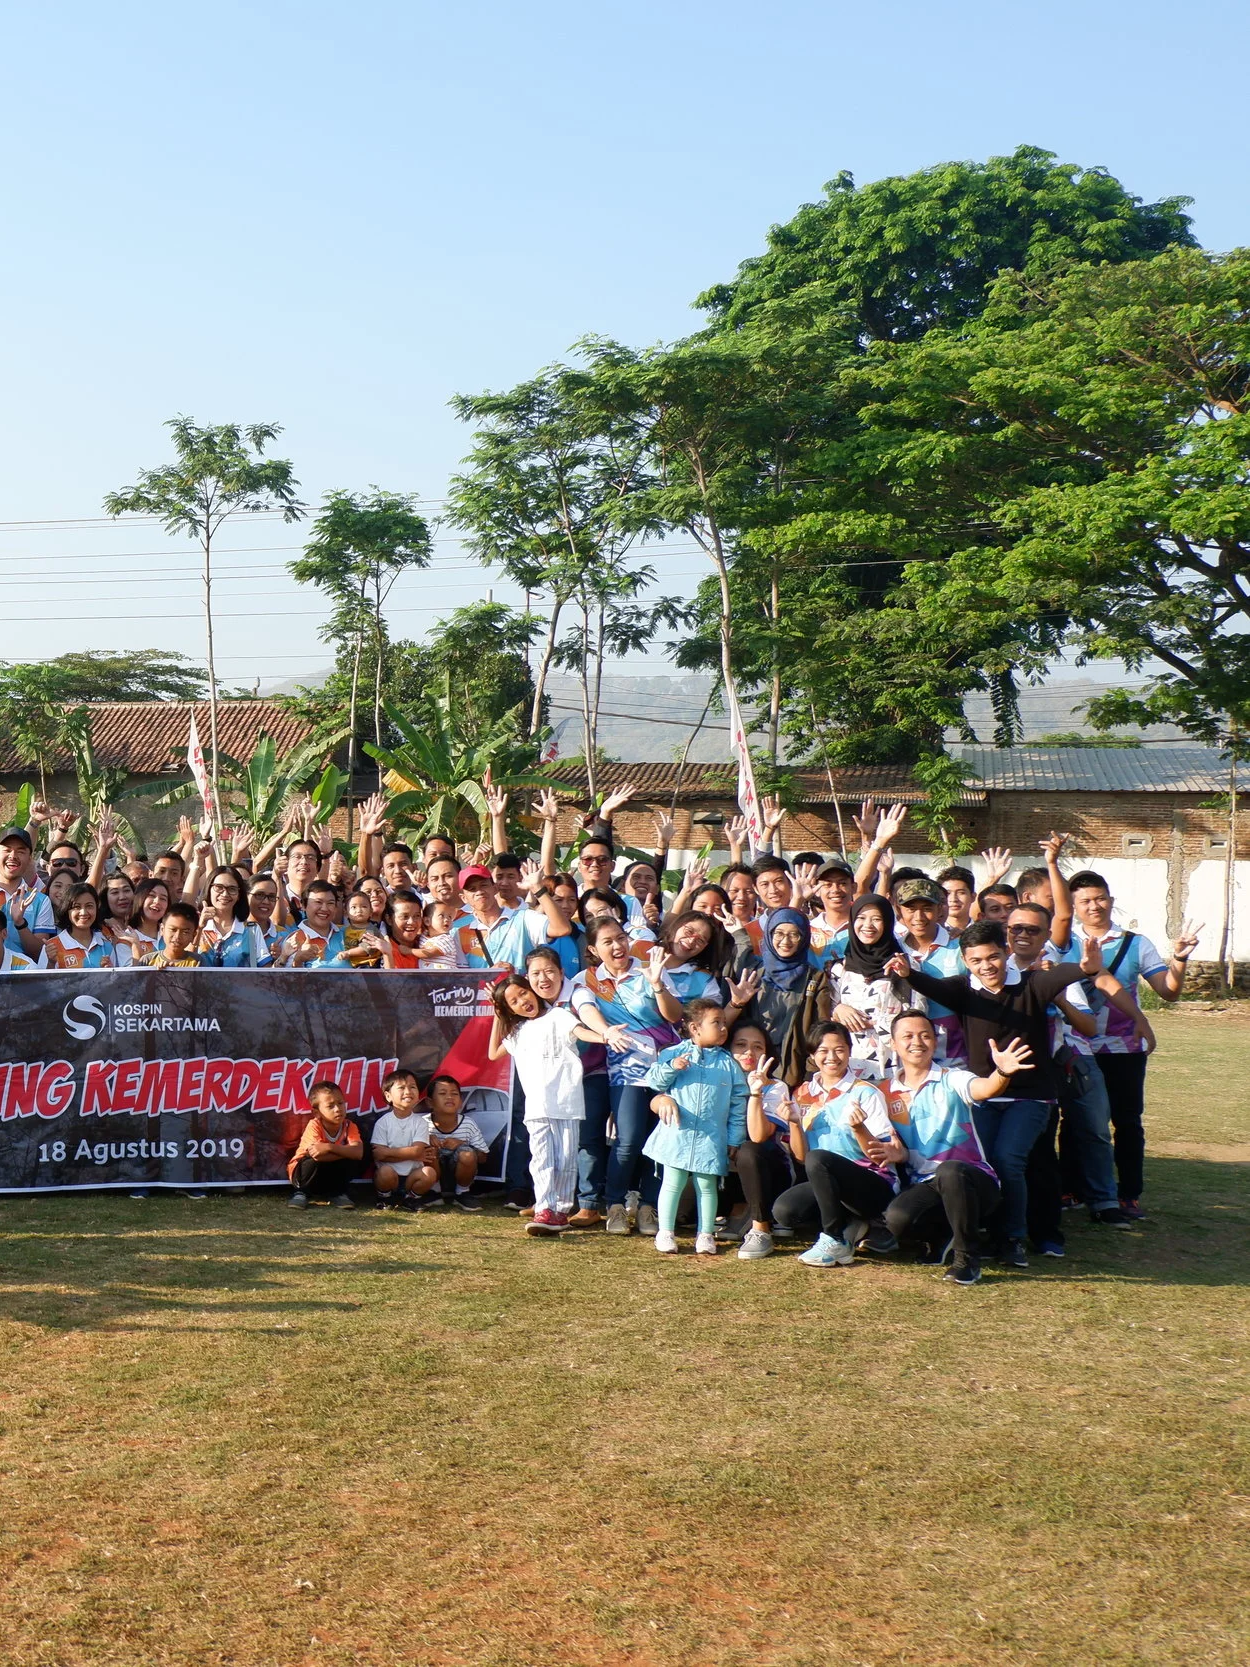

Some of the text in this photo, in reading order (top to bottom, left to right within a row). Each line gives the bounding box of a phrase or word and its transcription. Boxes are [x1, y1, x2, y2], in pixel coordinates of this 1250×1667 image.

[428, 986, 475, 1005] Touring
[113, 1004, 162, 1016] KOSPIN
[114, 1018, 221, 1032] SEKARTAMA
[39, 1137, 245, 1164] 18 Agustus 2019
